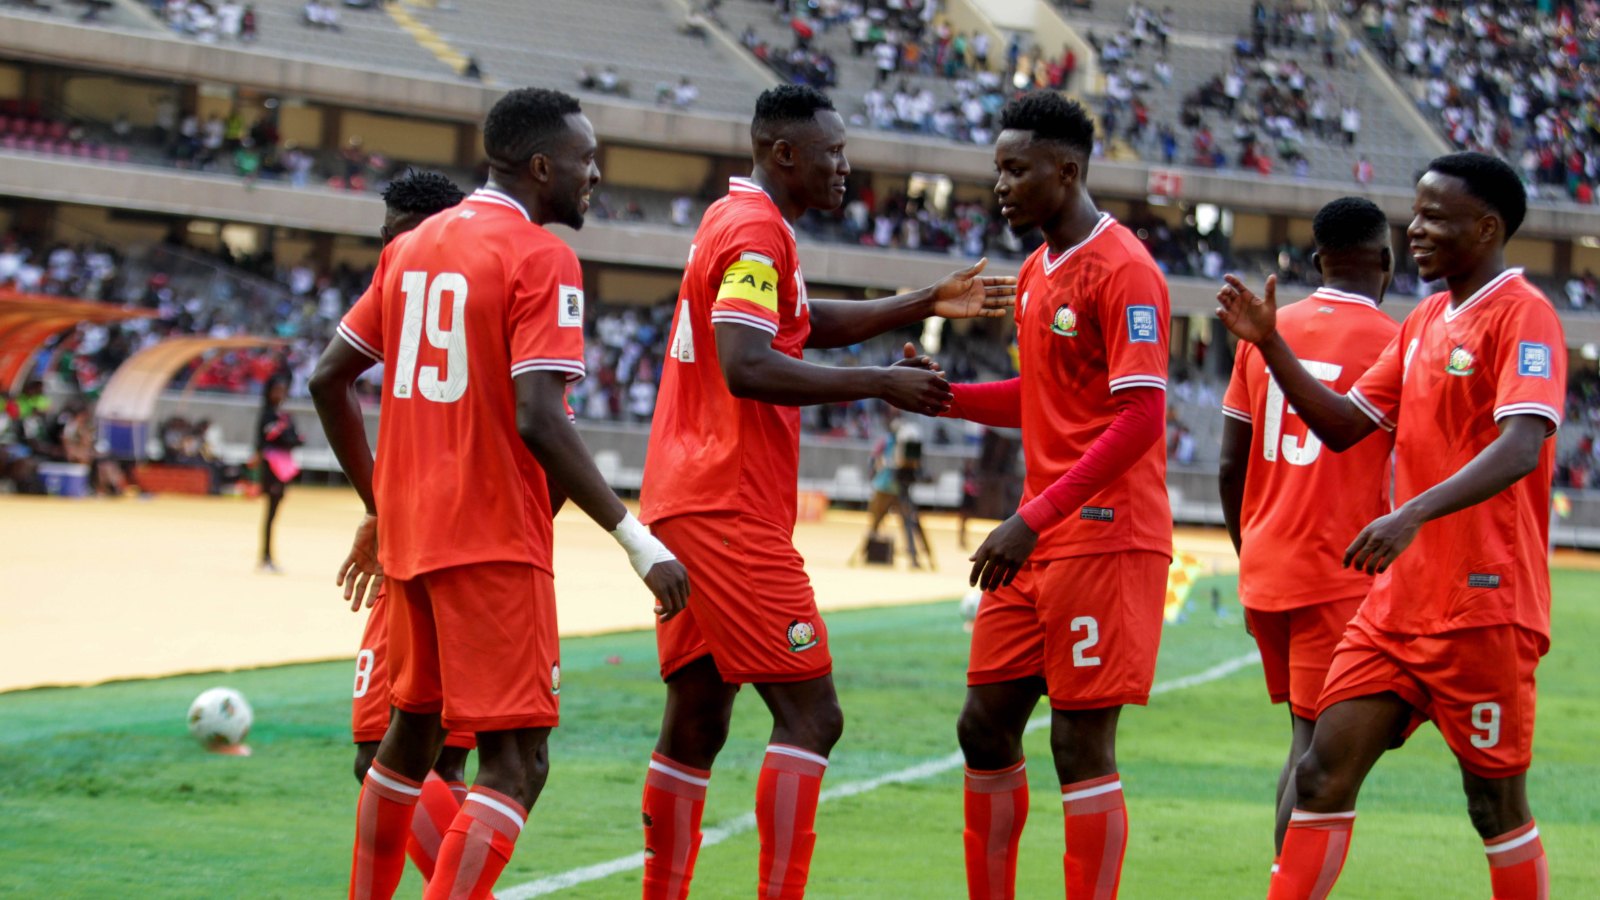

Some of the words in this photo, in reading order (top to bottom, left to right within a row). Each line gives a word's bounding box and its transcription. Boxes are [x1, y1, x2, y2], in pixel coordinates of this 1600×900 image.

[722, 273, 774, 292] CAF
[393, 271, 469, 403] 19
[1263, 359, 1343, 466] 15
[1070, 615, 1101, 668] 2
[1470, 701, 1501, 749] 9
